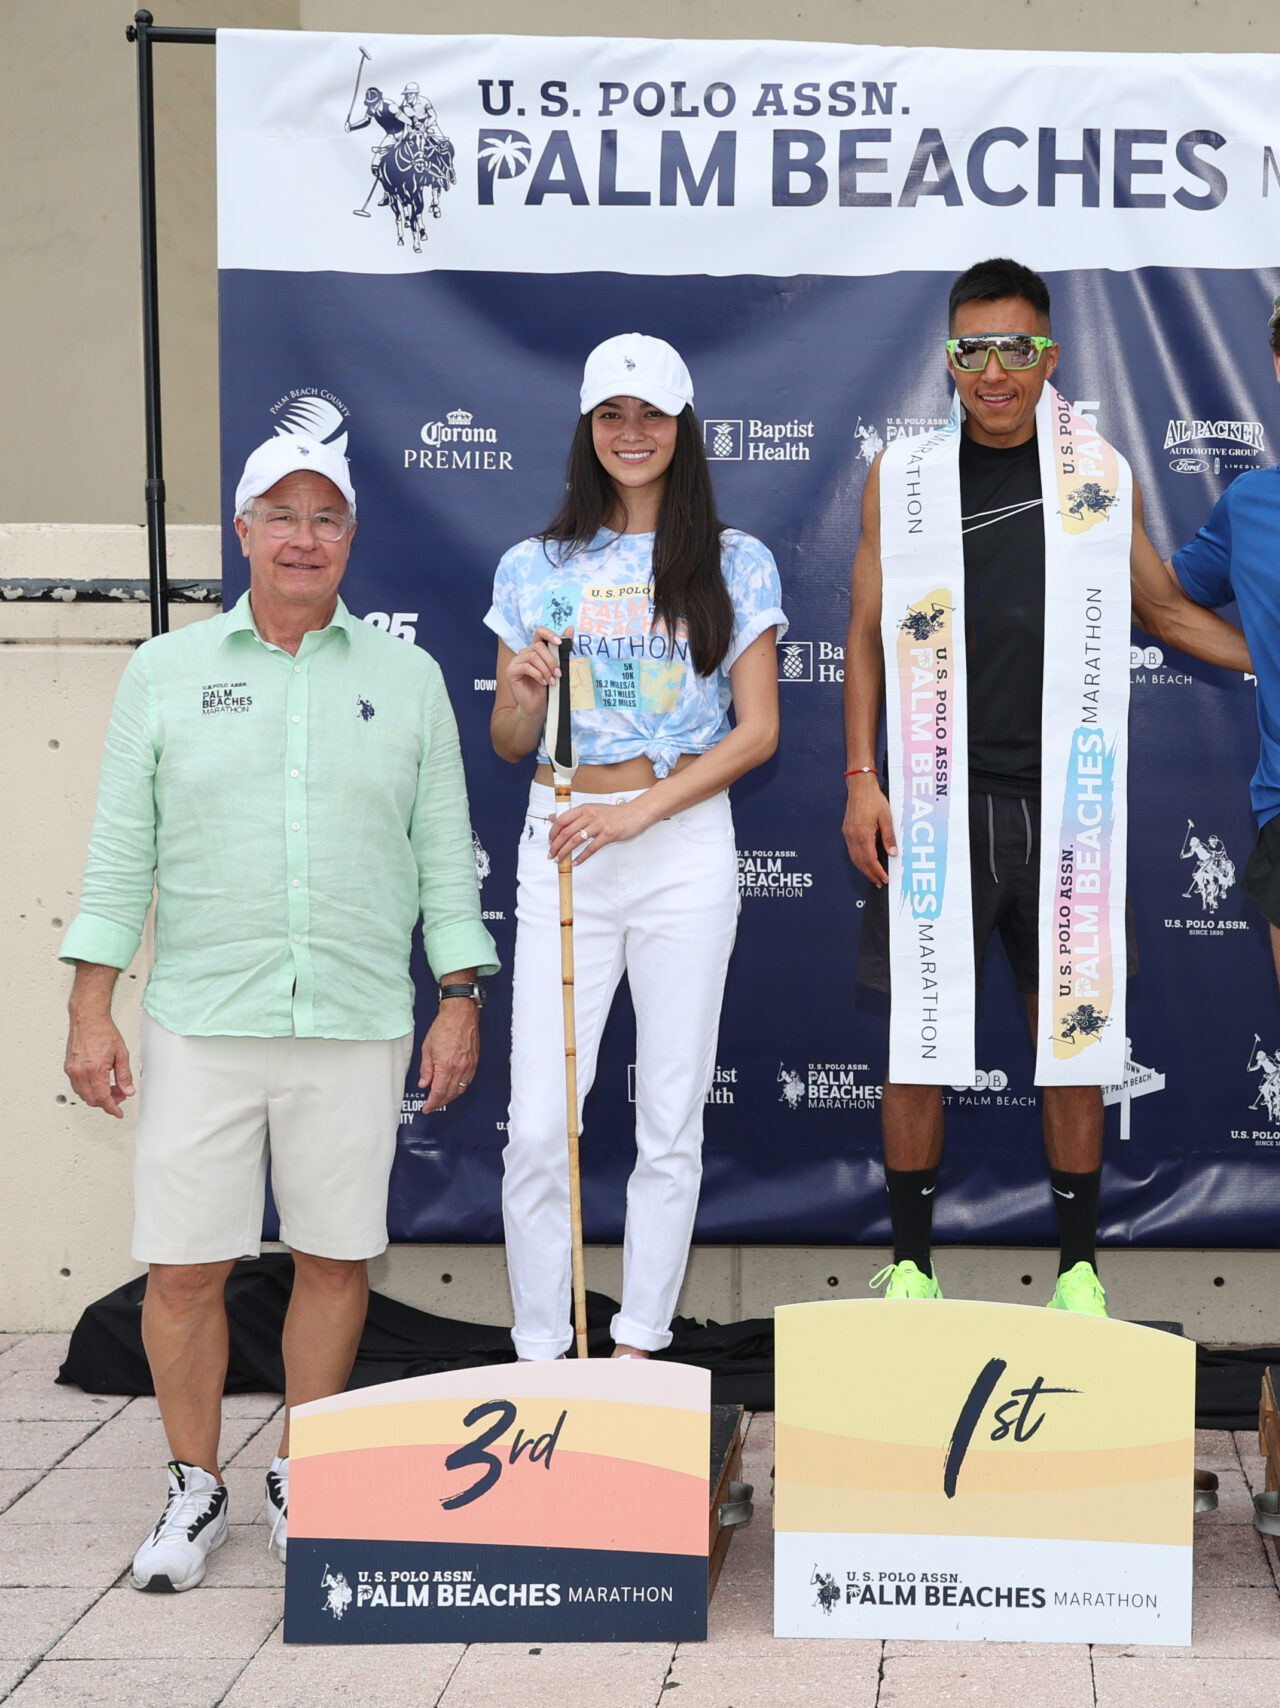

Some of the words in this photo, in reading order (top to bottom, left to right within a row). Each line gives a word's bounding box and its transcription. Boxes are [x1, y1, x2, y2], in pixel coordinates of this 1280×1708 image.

[598, 80, 737, 118] POLO
[752, 81, 911, 117] ASSN.
[476, 127, 737, 207] PALM
[771, 128, 1228, 211] BEACHES
[270, 395, 290, 415] PALM
[289, 387, 318, 399] BEACH
[320, 389, 351, 417] COUNTY
[420, 421, 499, 448] Corona
[748, 419, 815, 443] Baptist
[1163, 419, 1191, 450] AL
[1192, 420, 1265, 451] PACKER
[403, 449, 514, 470] PREMIER
[748, 442, 811, 461] Health
[1169, 447, 1227, 456] AUTOMOTIVE
[1228, 448, 1259, 457] GROUP
[1175, 460, 1202, 472] Ford
[619, 586, 651, 597] POLO
[581, 597, 649, 620] PALM
[1081, 587, 1103, 724] MARATHON
[623, 662, 634, 672] 5K
[595, 679, 609, 689] 26.2
[621, 671, 635, 681] 10K
[1151, 674, 1193, 685] BEACH
[202, 688, 233, 700] PALM
[202, 695, 253, 709] BEACHES
[617, 690, 636, 699] MILES
[910, 647, 935, 742] PALM
[602, 698, 618, 707] 26.2
[618, 699, 637, 708] MILES
[935, 690, 948, 740] POLO
[935, 744, 949, 802] ASSN.
[1075, 733, 1105, 895] BEACHES
[910, 752, 939, 915] BEACHES
[774, 850, 799, 858] ASSN.
[736, 872, 814, 888] BEACHES
[1060, 843, 1075, 901] ASSN.
[1058, 904, 1072, 956] POLO
[1186, 919, 1215, 929] POLO
[1217, 920, 1250, 930] ASSN.
[1073, 901, 1101, 999] PALM
[917, 923, 939, 1060] MARATHON
[825, 1063, 846, 1071] POLO
[807, 1070, 855, 1086] PALM
[1130, 1073, 1152, 1087] BEACH
[807, 1085, 884, 1100] BEACHES
[807, 1099, 875, 1110] MARATHON
[958, 1096, 991, 1106] PALM
[996, 1096, 1037, 1107] BEACH
[1252, 1131, 1280, 1140] POLO
[942, 1356, 1086, 1499] 1st
[439, 1399, 568, 1511] 3rd
[390, 1570, 430, 1583] POLO
[433, 1570, 477, 1583] ASSN.
[878, 1572, 917, 1583] POLO
[920, 1572, 963, 1584] ASSN.
[356, 1584, 430, 1608] PALM
[437, 1583, 561, 1608] BEACHES
[568, 1586, 674, 1603] MARATHON
[845, 1584, 917, 1607] PALM
[924, 1586, 1047, 1609] BEACHES
[1053, 1591, 1159, 1609] MARATHON
